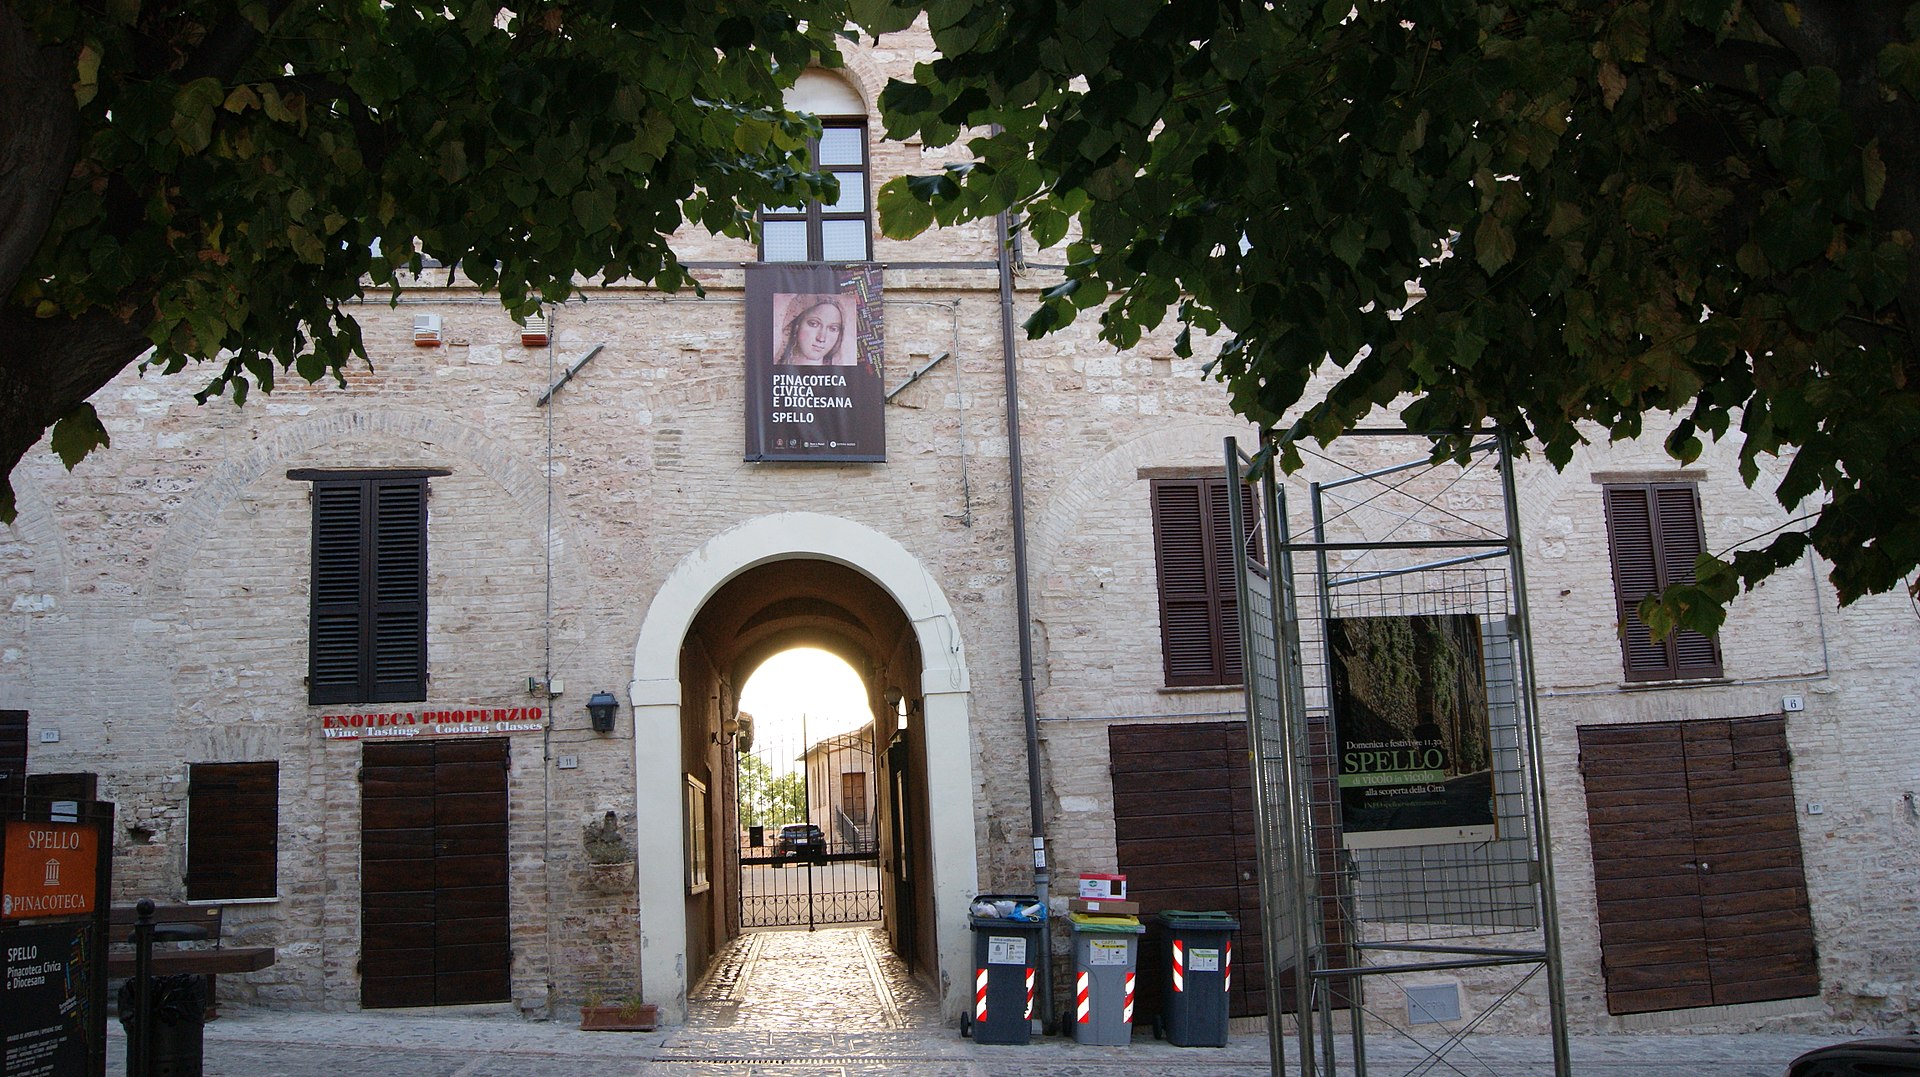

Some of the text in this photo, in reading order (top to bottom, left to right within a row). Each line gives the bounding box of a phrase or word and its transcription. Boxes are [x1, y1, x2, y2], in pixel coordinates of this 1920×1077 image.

[772, 374, 847, 387] PINACOTECA
[772, 386, 814, 397] CIVICA
[773, 397, 853, 408] E DIOCESANA
[772, 412, 814, 423] SPELLO
[1790, 699, 1797, 709] 6
[321, 706, 543, 729] ENOTECA PROPERZIO
[45, 732, 54, 740] 10
[323, 721, 543, 738] Wine Tastings Cooking Classes
[1346, 740, 1384, 750] Domenica
[1389, 739, 1411, 748] festivi
[1424, 739, 1442, 748] 11.30
[1344, 748, 1444, 773] SPELLO
[1352, 770, 1434, 785] di vicolo in vicolo
[1365, 784, 1446, 796] alla scoperta della Città
[28, 830, 80, 850] SPELLO
[14, 893, 86, 912] PINACOTECA
[8, 945, 38, 963] SPELLO
[8, 961, 61, 979] Pinacoteca Civica
[7, 974, 45, 990] e Diocesana
